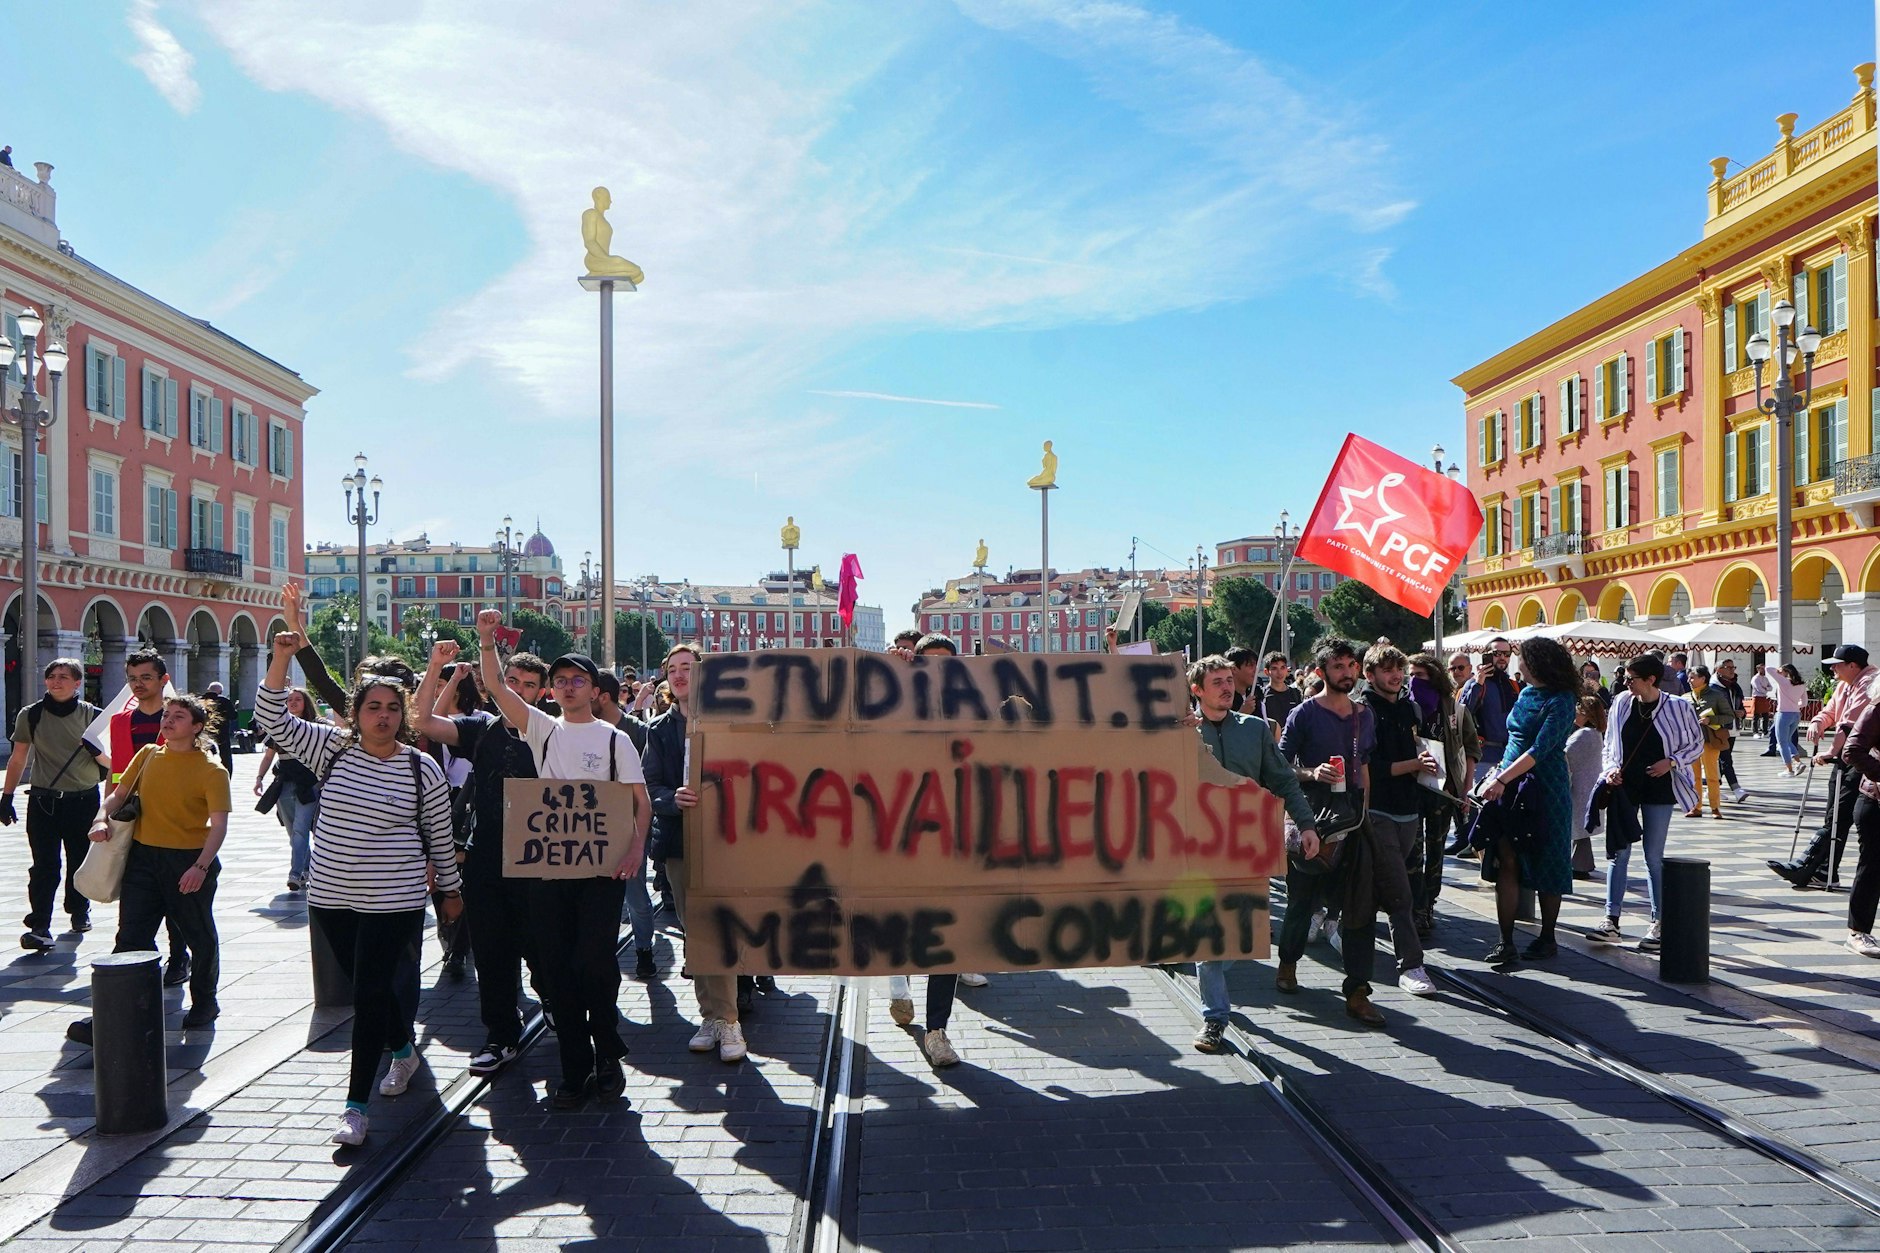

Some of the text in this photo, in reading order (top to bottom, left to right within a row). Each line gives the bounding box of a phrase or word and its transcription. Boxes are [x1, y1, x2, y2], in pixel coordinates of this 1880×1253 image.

[1326, 538, 1433, 594] PARTI COMMUNISTE FRANÇAIS
[1380, 532, 1449, 577] PCF
[527, 811, 608, 835] CRIME
[713, 862, 1269, 970] MÊME COMBAT
